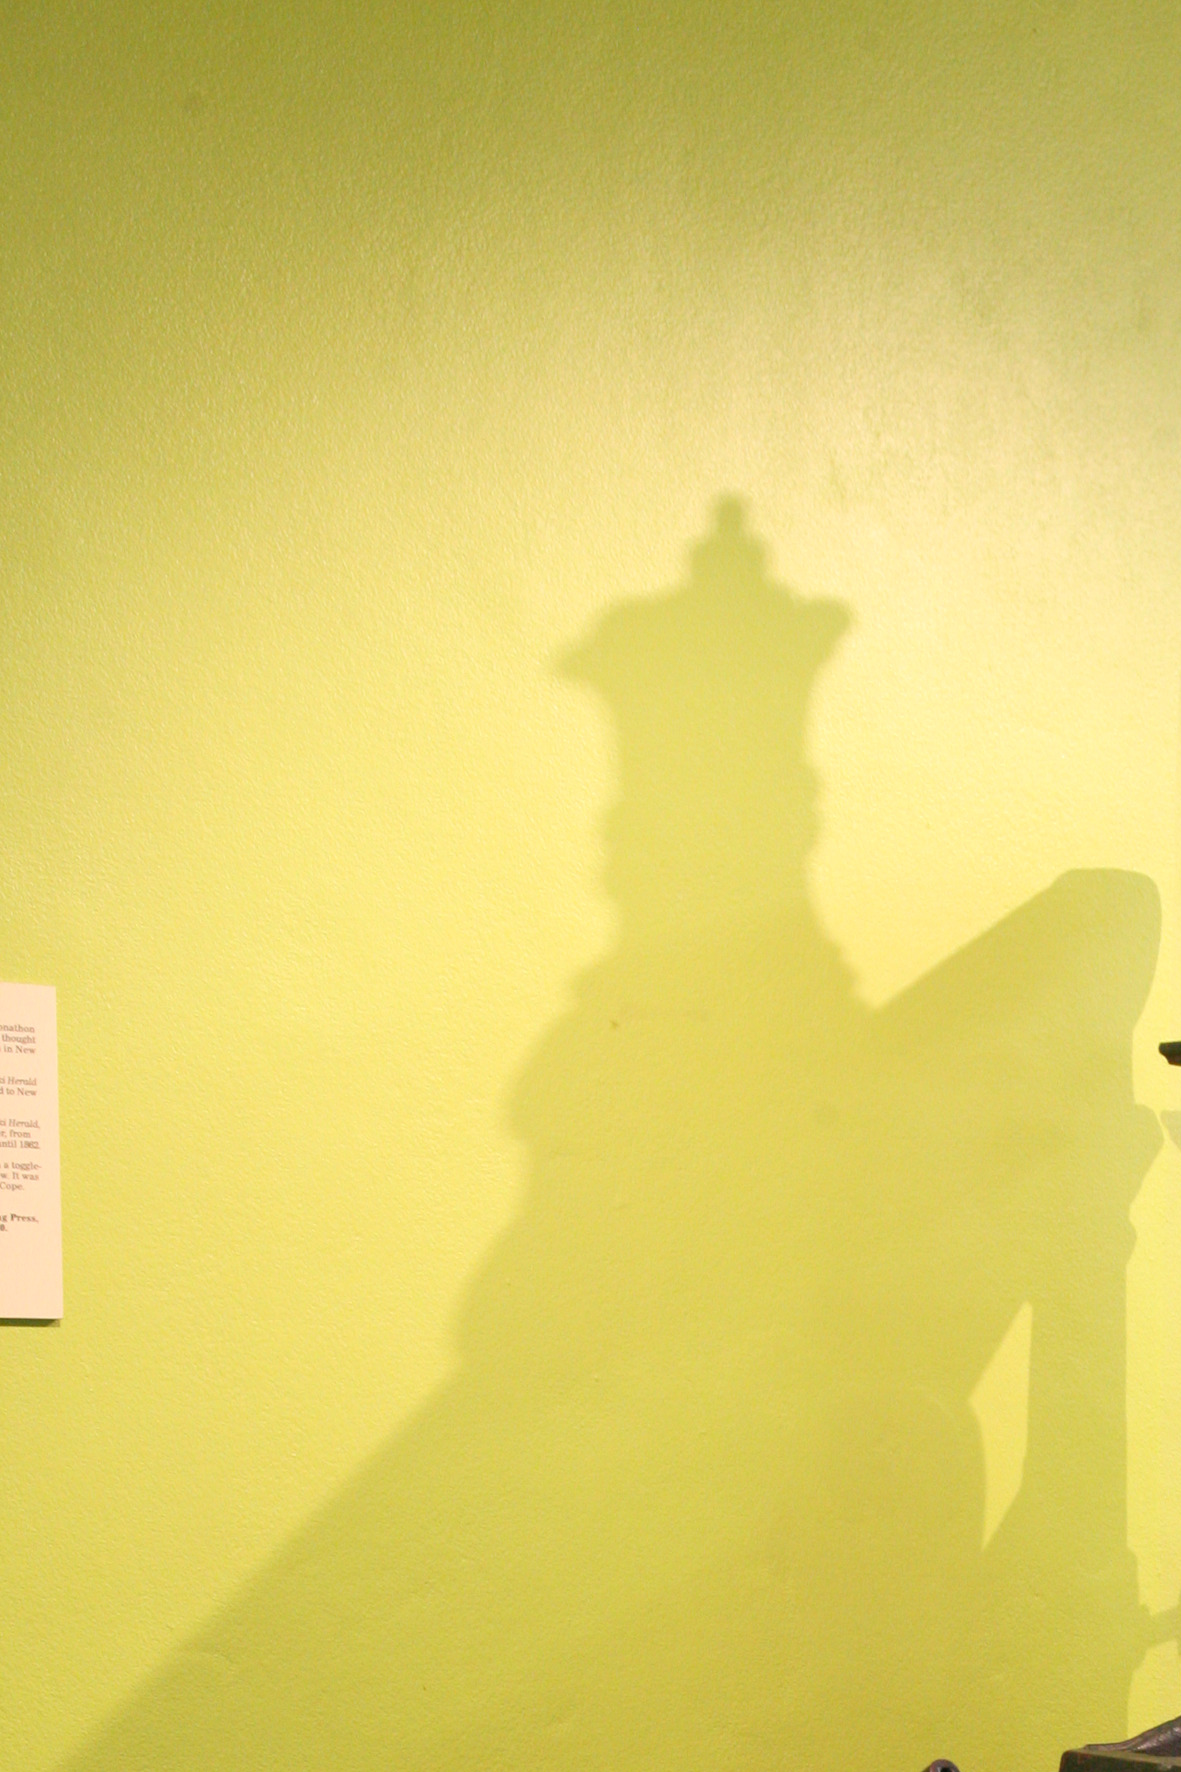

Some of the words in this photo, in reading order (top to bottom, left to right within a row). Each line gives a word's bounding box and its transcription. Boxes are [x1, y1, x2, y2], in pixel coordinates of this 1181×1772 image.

[2, 1033, 36, 1044] thought
[4, 1045, 13, 1053] in
[16, 1045, 36, 1054] New
[7, 1076, 37, 1086] Herald
[17, 1087, 37, 1096] New
[9, 1129, 31, 1138] from
[12, 1171, 20, 1180] It
